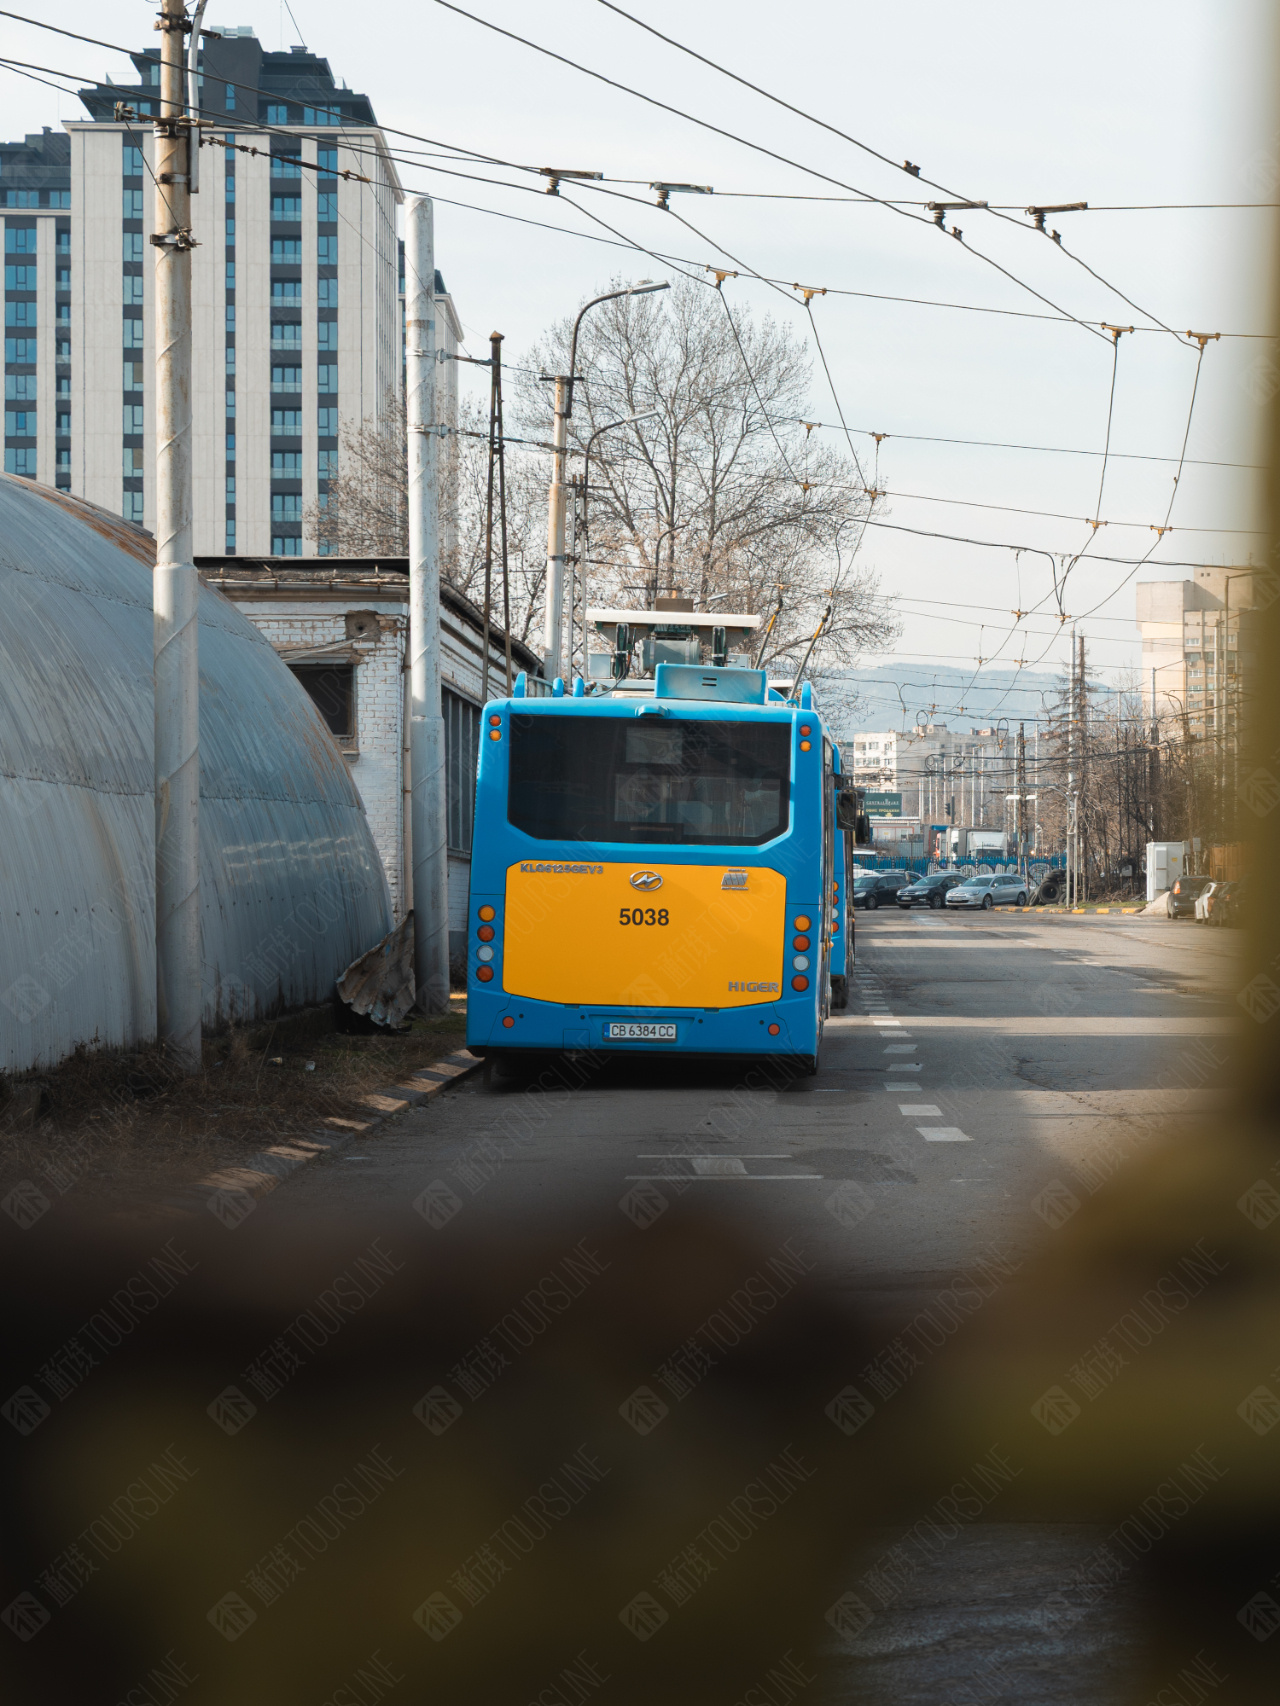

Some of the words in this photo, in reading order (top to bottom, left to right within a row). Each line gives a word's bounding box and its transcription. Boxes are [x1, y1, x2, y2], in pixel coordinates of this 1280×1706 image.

[520, 863, 604, 874] KLQ6125GEV3
[618, 908, 670, 926] 5038
[728, 981, 779, 992] HIGER
[628, 1025, 656, 1037] 6384
